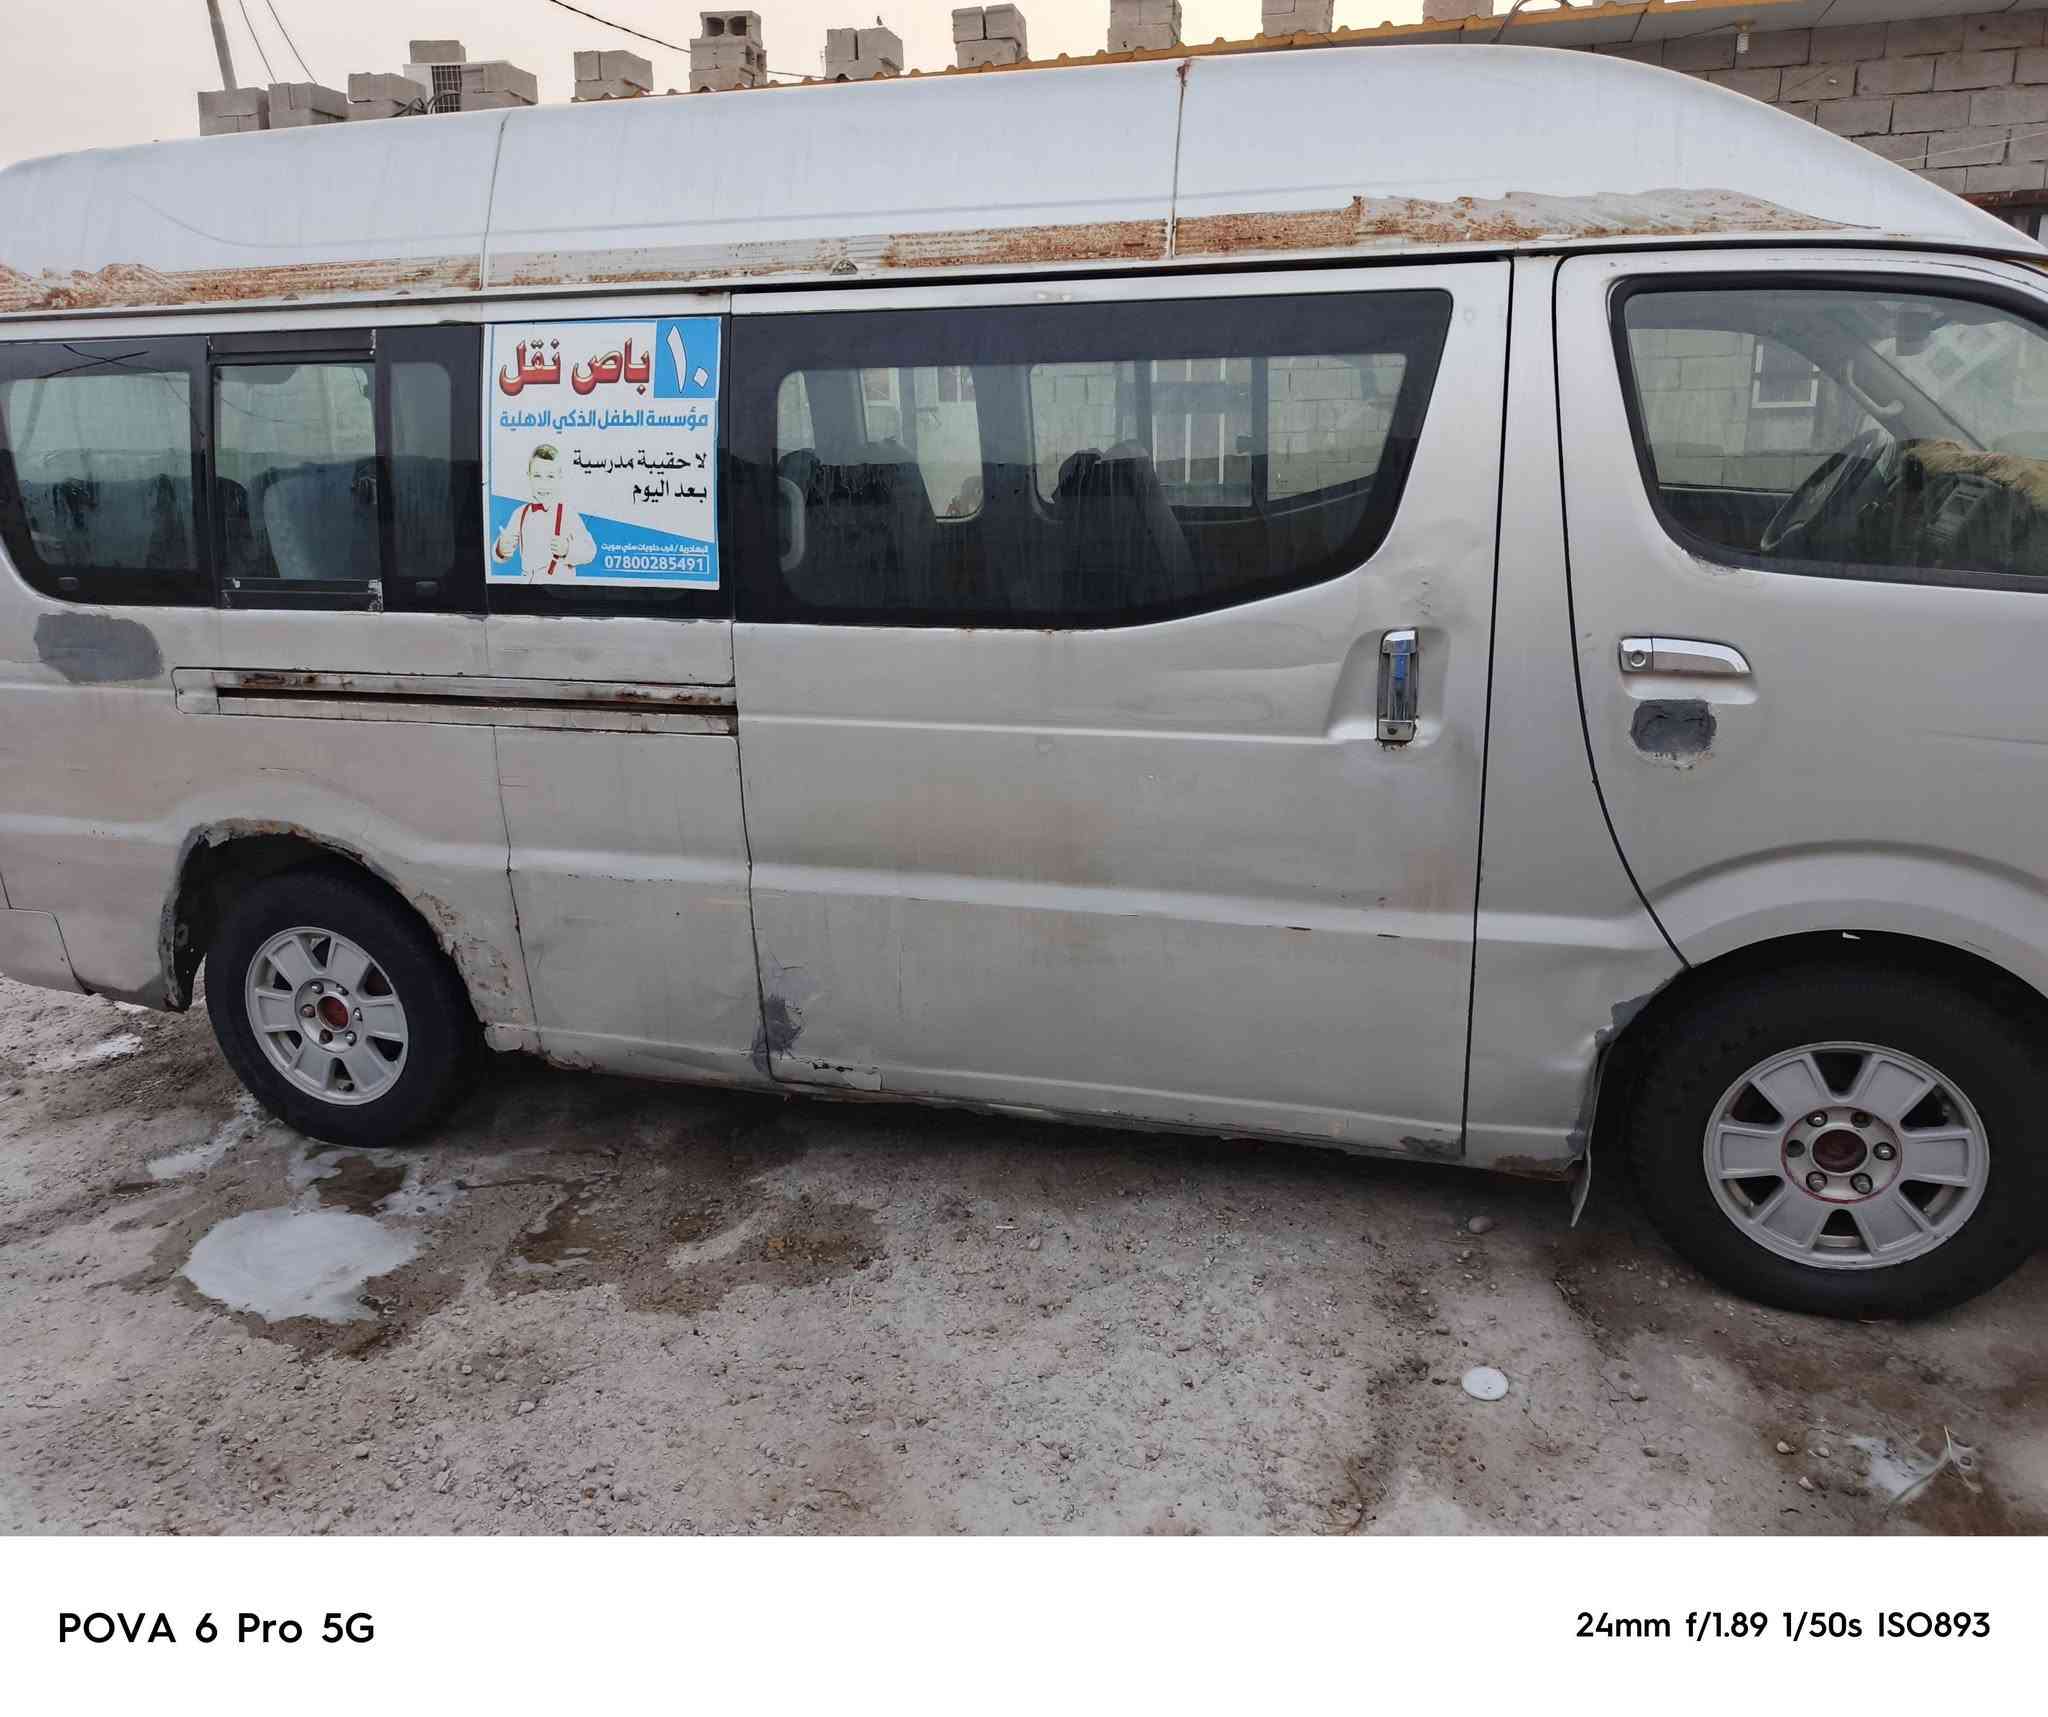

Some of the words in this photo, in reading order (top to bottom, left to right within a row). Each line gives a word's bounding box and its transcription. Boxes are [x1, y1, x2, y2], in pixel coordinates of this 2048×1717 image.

[499, 338, 561, 397] نقل
[571, 337, 650, 396] باص
[666, 323, 710, 394] ١٠
[499, 409, 551, 432] الاهلية
[552, 408, 597, 434] الذكي
[598, 408, 644, 430] الطفل
[646, 407, 709, 432] مؤسسة
[572, 449, 635, 474] مدرسية
[636, 450, 691, 475] حقيبة
[695, 451, 708, 470] لا
[632, 479, 670, 504] اليوم
[674, 484, 708, 503] بعد
[604, 555, 704, 571] 07800285491
